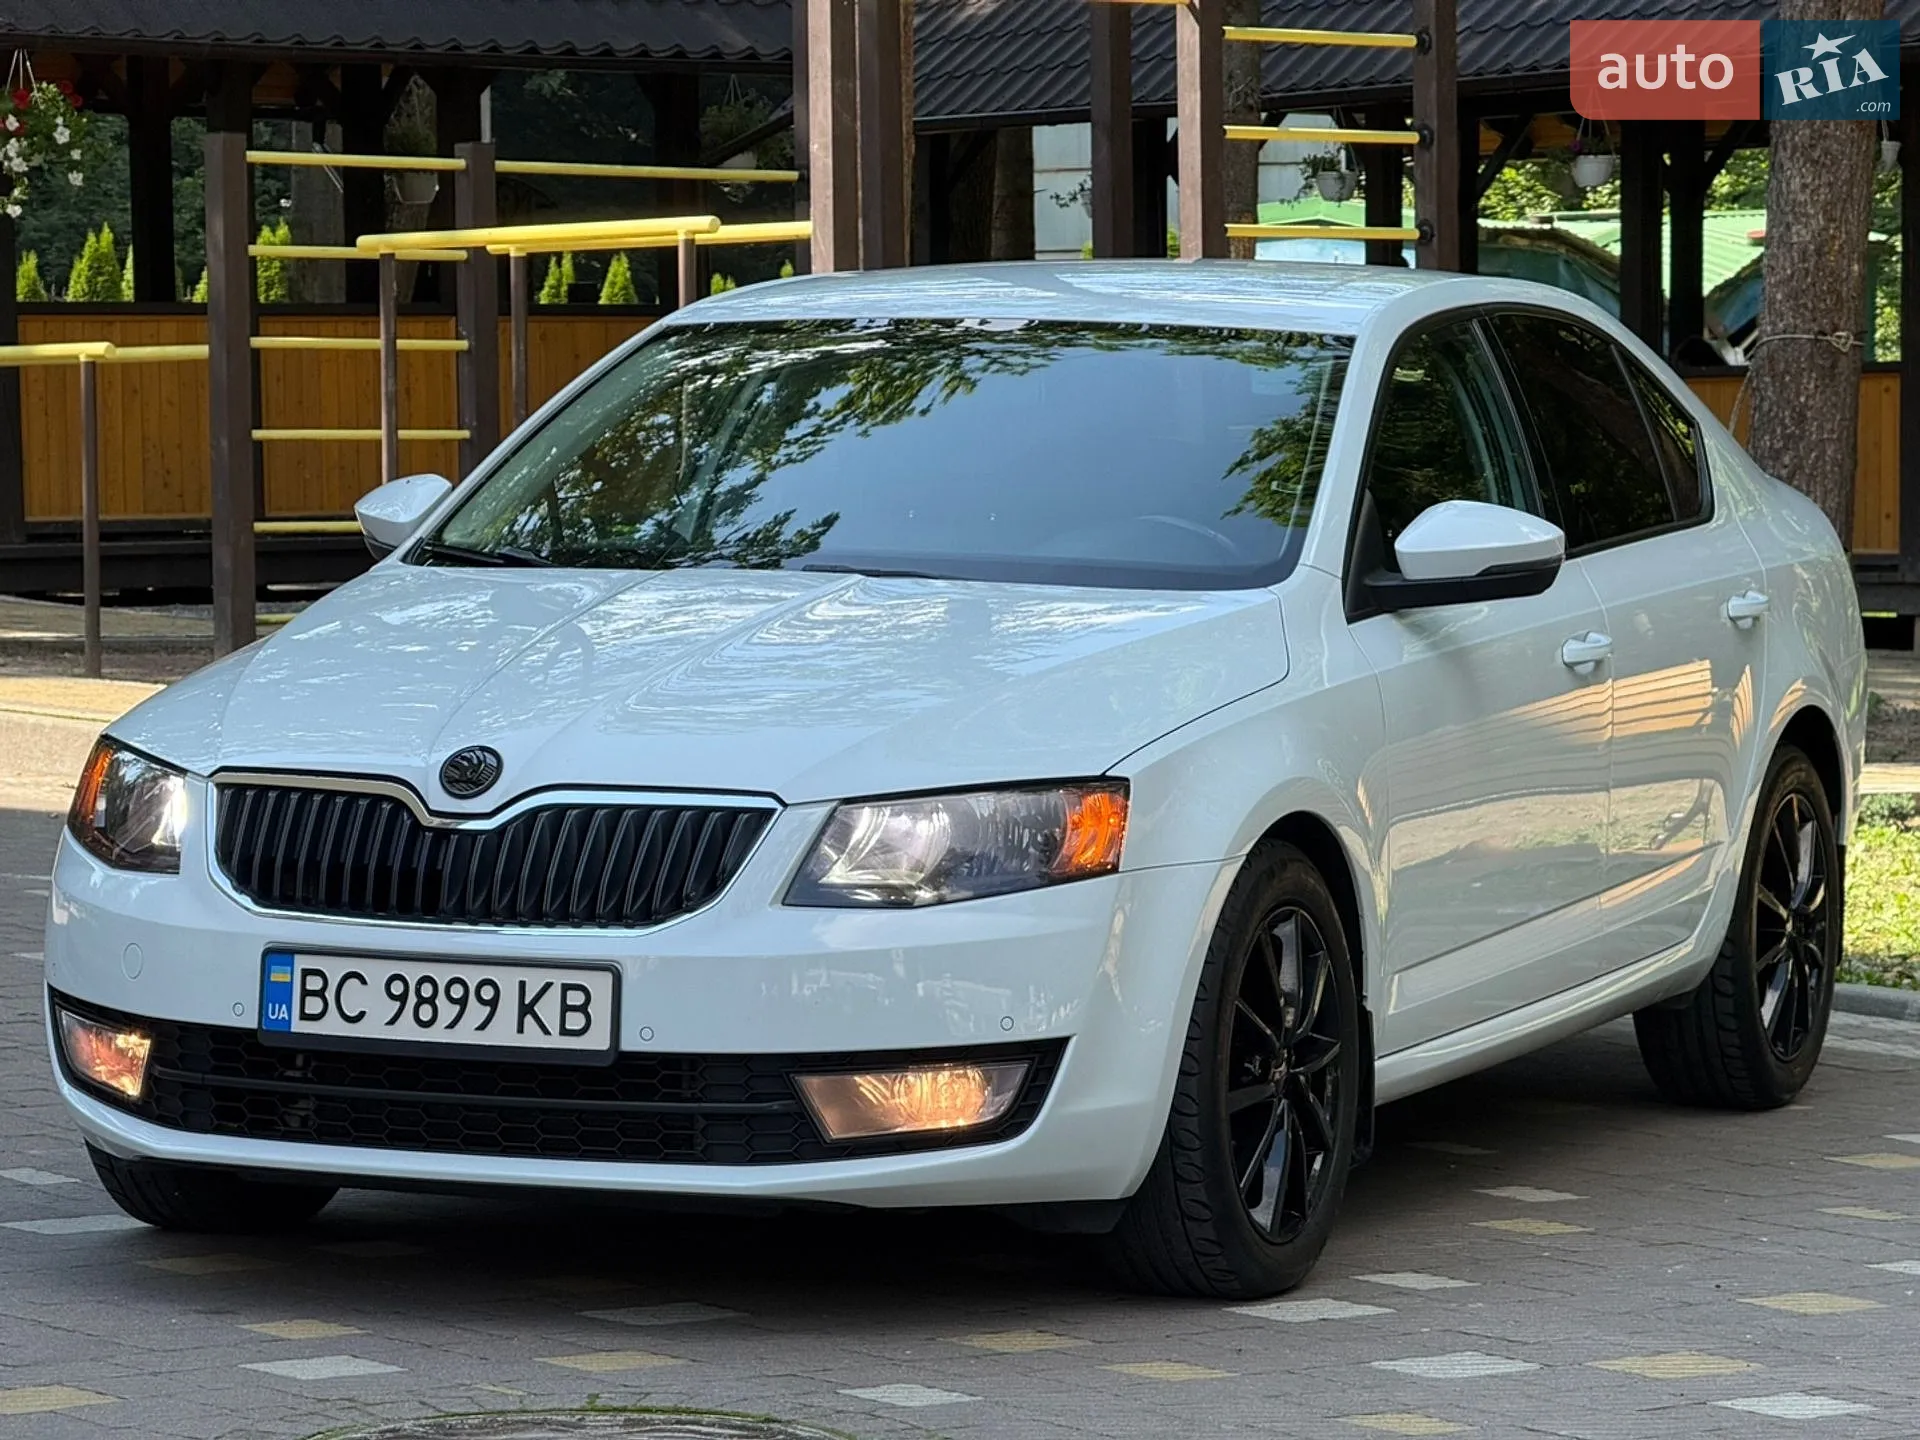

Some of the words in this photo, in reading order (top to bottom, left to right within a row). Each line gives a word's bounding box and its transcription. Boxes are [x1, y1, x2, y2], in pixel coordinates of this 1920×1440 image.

[268, 1002, 289, 1021] UA
[299, 967, 369, 1024] BC
[383, 972, 501, 1031] 9899
[516, 979, 593, 1037] KB
